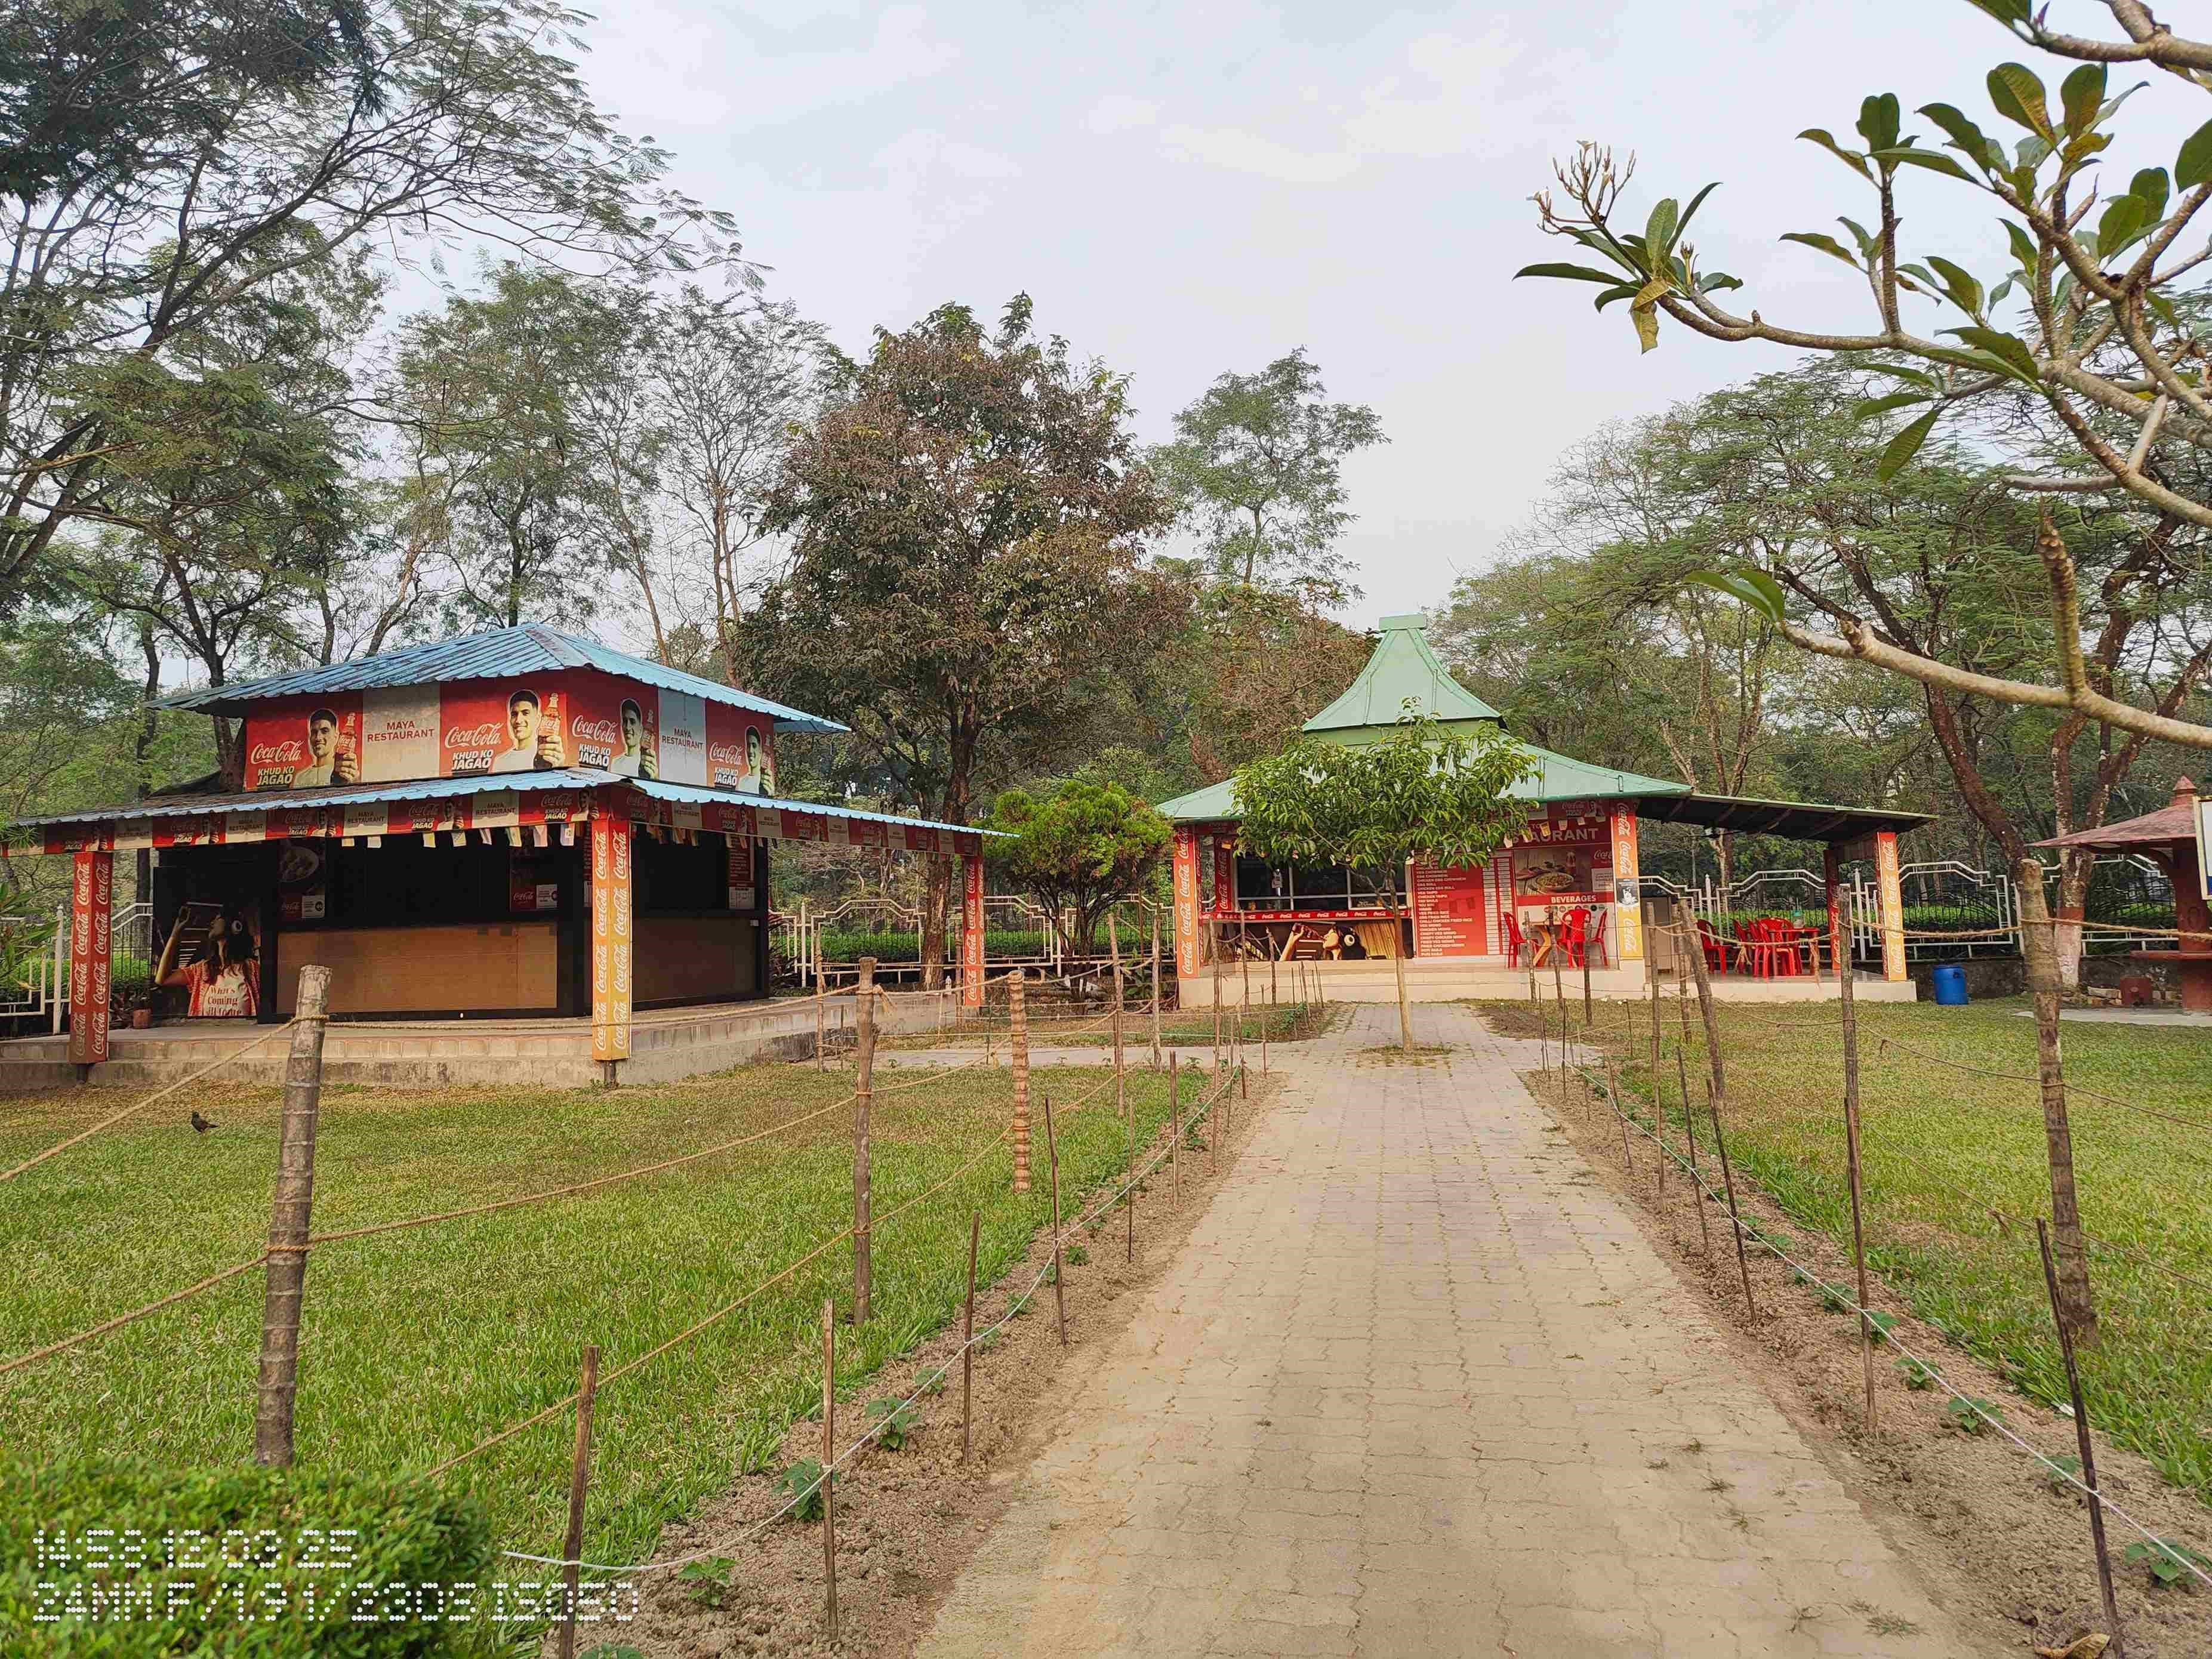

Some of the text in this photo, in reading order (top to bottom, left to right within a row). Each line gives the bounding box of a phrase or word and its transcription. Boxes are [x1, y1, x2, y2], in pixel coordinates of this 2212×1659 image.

[387, 721, 415, 730] MAYA
[572, 715, 618, 744] Coca-Cola
[367, 729, 435, 742] RESTAURANT
[445, 722, 504, 748] Coca-Cola
[674, 727, 692, 739] MAYA
[661, 735, 704, 750] RESTAURANT
[251, 740, 305, 764] Coca-Cola
[452, 750, 494, 760] KHUD KO
[579, 744, 611, 756] KHUD KO
[710, 741, 744, 764] Coca-Cola
[452, 758, 491, 770] JAGAO
[578, 752, 609, 766] JAGAO
[258, 766, 295, 776] KHUD KO
[714, 767, 729, 775] KHUD
[257, 774, 293, 785] JAGAO
[714, 773, 737, 785] JAGAO
[595, 831, 606, 879] Coca-Cola
[613, 830, 626, 879] Coca-Cola
[76, 861, 90, 905] Coca-Cola
[75, 911, 88, 955] Coca-Cola
[74, 961, 87, 1005] Coca-Cola
[93, 961, 107, 1005] Coca-Cola
[208, 997, 238, 1006] Coming
[92, 1011, 106, 1054] Coca-Cola
